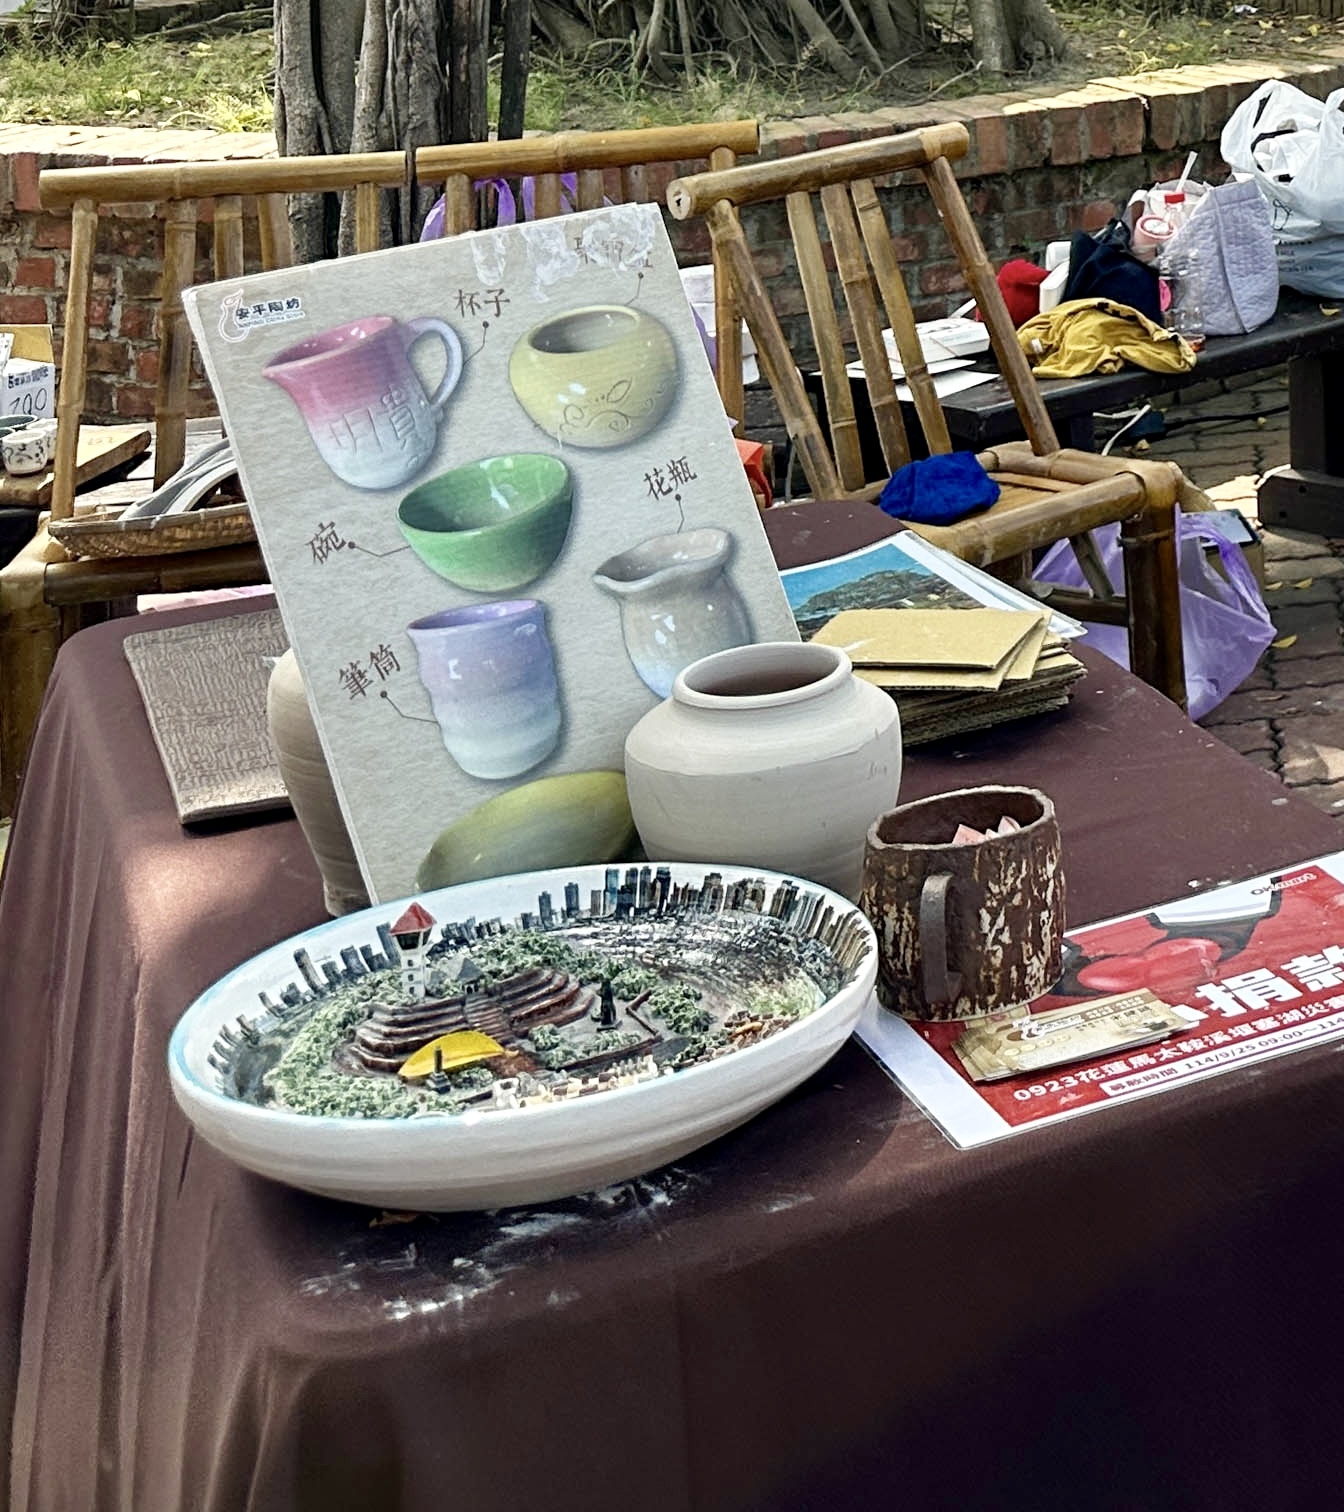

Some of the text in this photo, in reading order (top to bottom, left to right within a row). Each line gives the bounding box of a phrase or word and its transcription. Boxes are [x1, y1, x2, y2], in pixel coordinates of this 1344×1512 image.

[235, 297, 300, 320] 安平陶坊
[456, 289, 511, 318] 杯子
[642, 454, 698, 502] 花瓶
[308, 521, 346, 566] 碗
[338, 643, 402, 701] 筆筒
